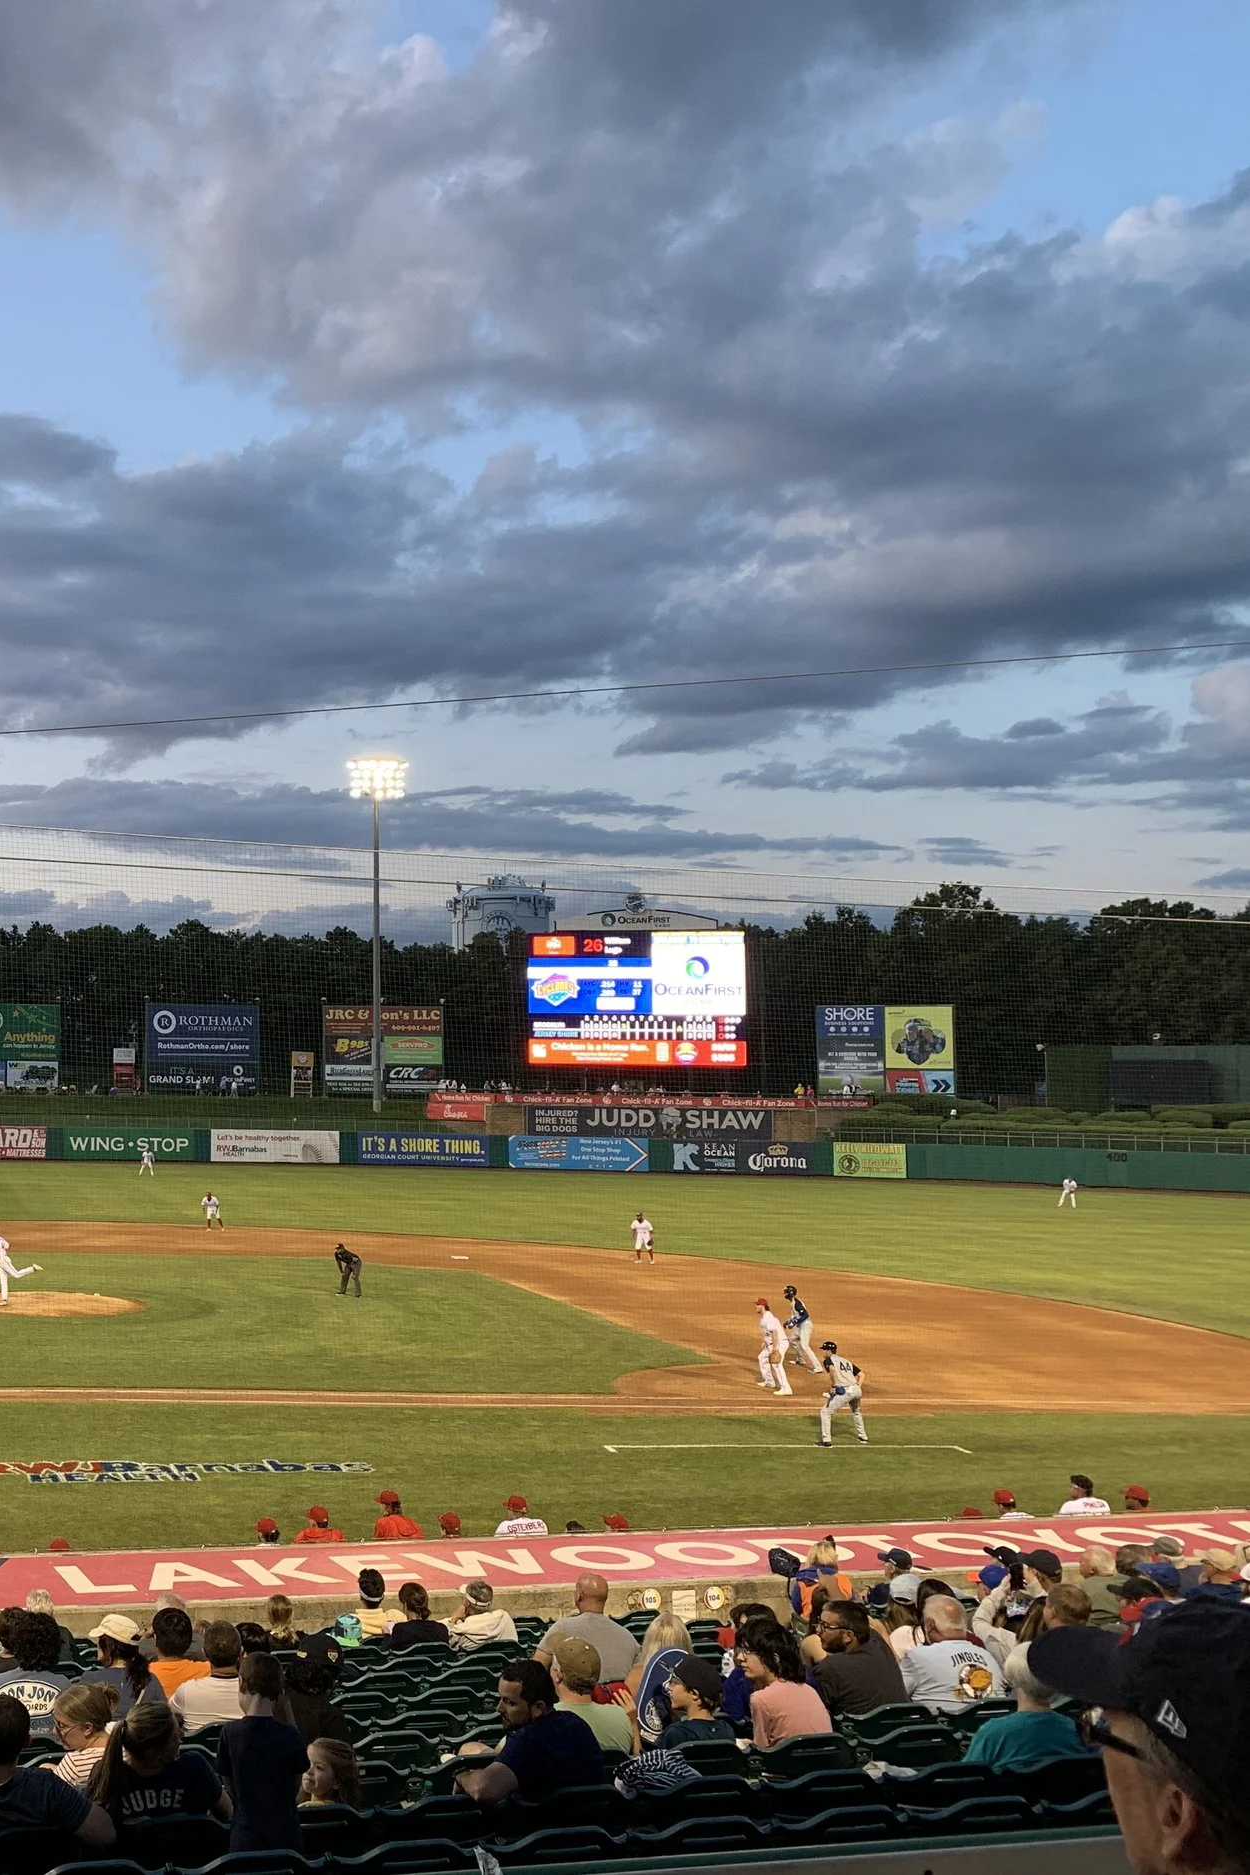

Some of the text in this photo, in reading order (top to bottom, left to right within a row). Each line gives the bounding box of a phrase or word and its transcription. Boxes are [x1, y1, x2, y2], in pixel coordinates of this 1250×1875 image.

[583, 938, 603, 952] 26
[326, 1009, 441, 1021] JRC & on's LLC
[825, 1007, 874, 1021] SHORE
[179, 1015, 253, 1026] ROTHMAN
[4, 1031, 55, 1044] Anything
[157, 1042, 250, 1052] RothmanOrtho.com/shore
[389, 1066, 424, 1079] CRC
[150, 1075, 183, 1084] GRAND
[675, 1098, 693, 1106] Zone
[535, 1109, 579, 1117] INJURED?
[560, 1117, 578, 1125] THE
[586, 1108, 765, 1130] JUDD SHAW
[535, 1124, 578, 1133] BIG DOGS
[614, 1128, 713, 1138] INJURY LAW
[31, 1138, 47, 1149] SON
[245, 1134, 270, 1143] healthy
[216, 1144, 267, 1153] RWJBarnabas
[362, 1136, 485, 1155] IT'S A SHORE THING.
[704, 1142, 736, 1150] KEAN
[6, 1149, 47, 1158] MATTRESSES
[1107, 1152, 1128, 1163] 400
[748, 1152, 807, 1172] Corona
[28, 1471, 202, 1484] HEALTH
[27, 1685, 56, 1703] JON
[121, 1788, 185, 1815] JUDGE
